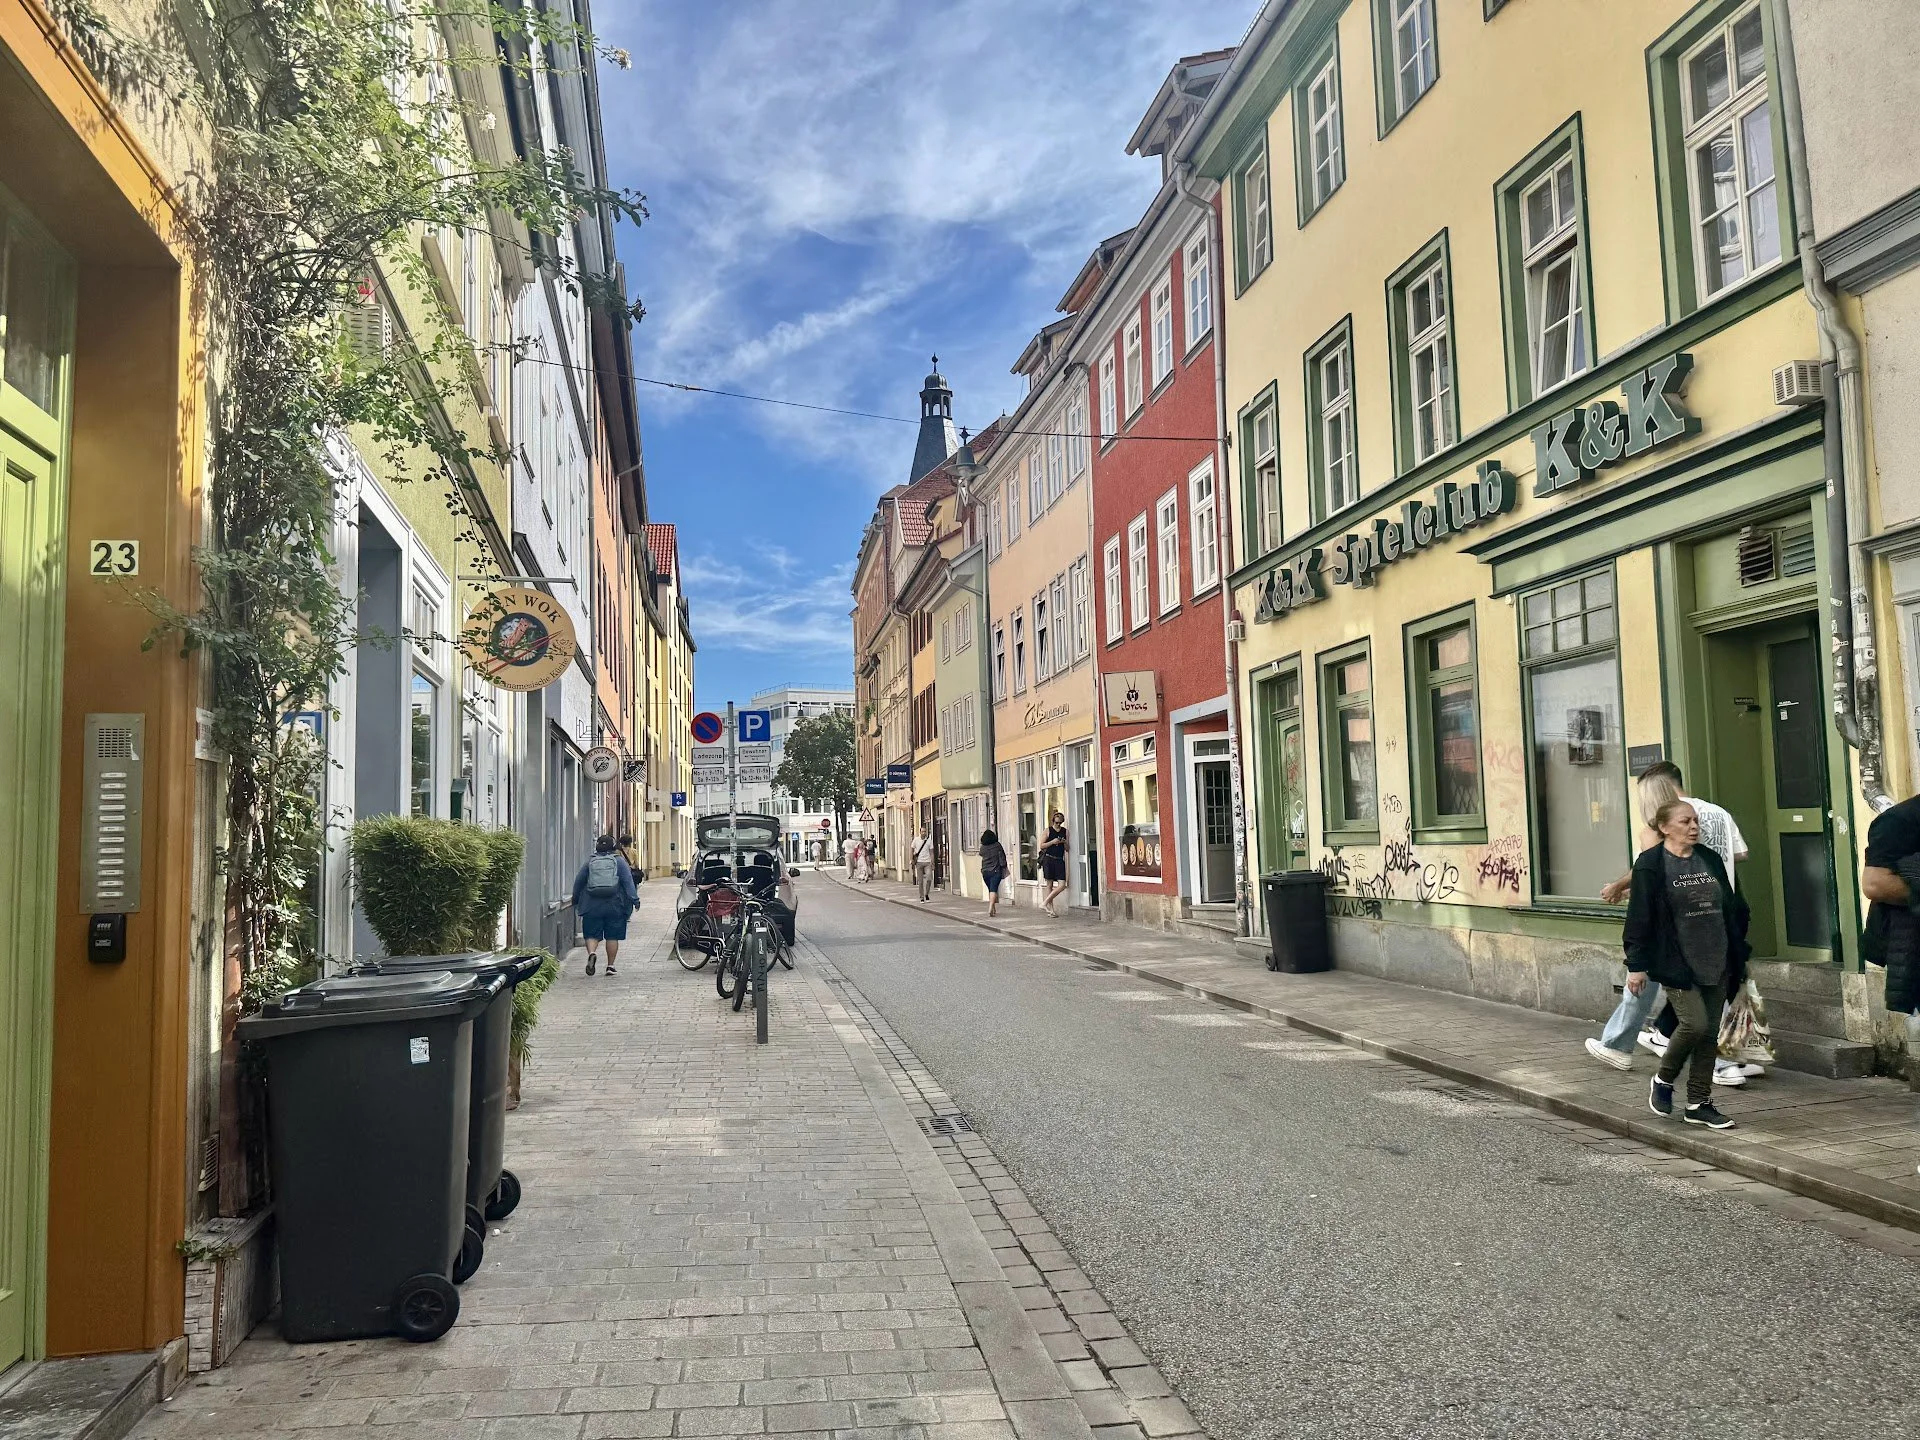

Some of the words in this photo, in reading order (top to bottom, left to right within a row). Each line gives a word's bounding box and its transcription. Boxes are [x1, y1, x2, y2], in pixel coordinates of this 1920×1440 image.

[1530, 353, 1701, 498] K&K
[93, 542, 136, 573] 23
[1253, 548, 1327, 625] K&K
[1332, 460, 1516, 589] Spielclub
[523, 594, 562, 624] WOK
[745, 714, 764, 739] P
[1672, 877, 1700, 888] Crystal
